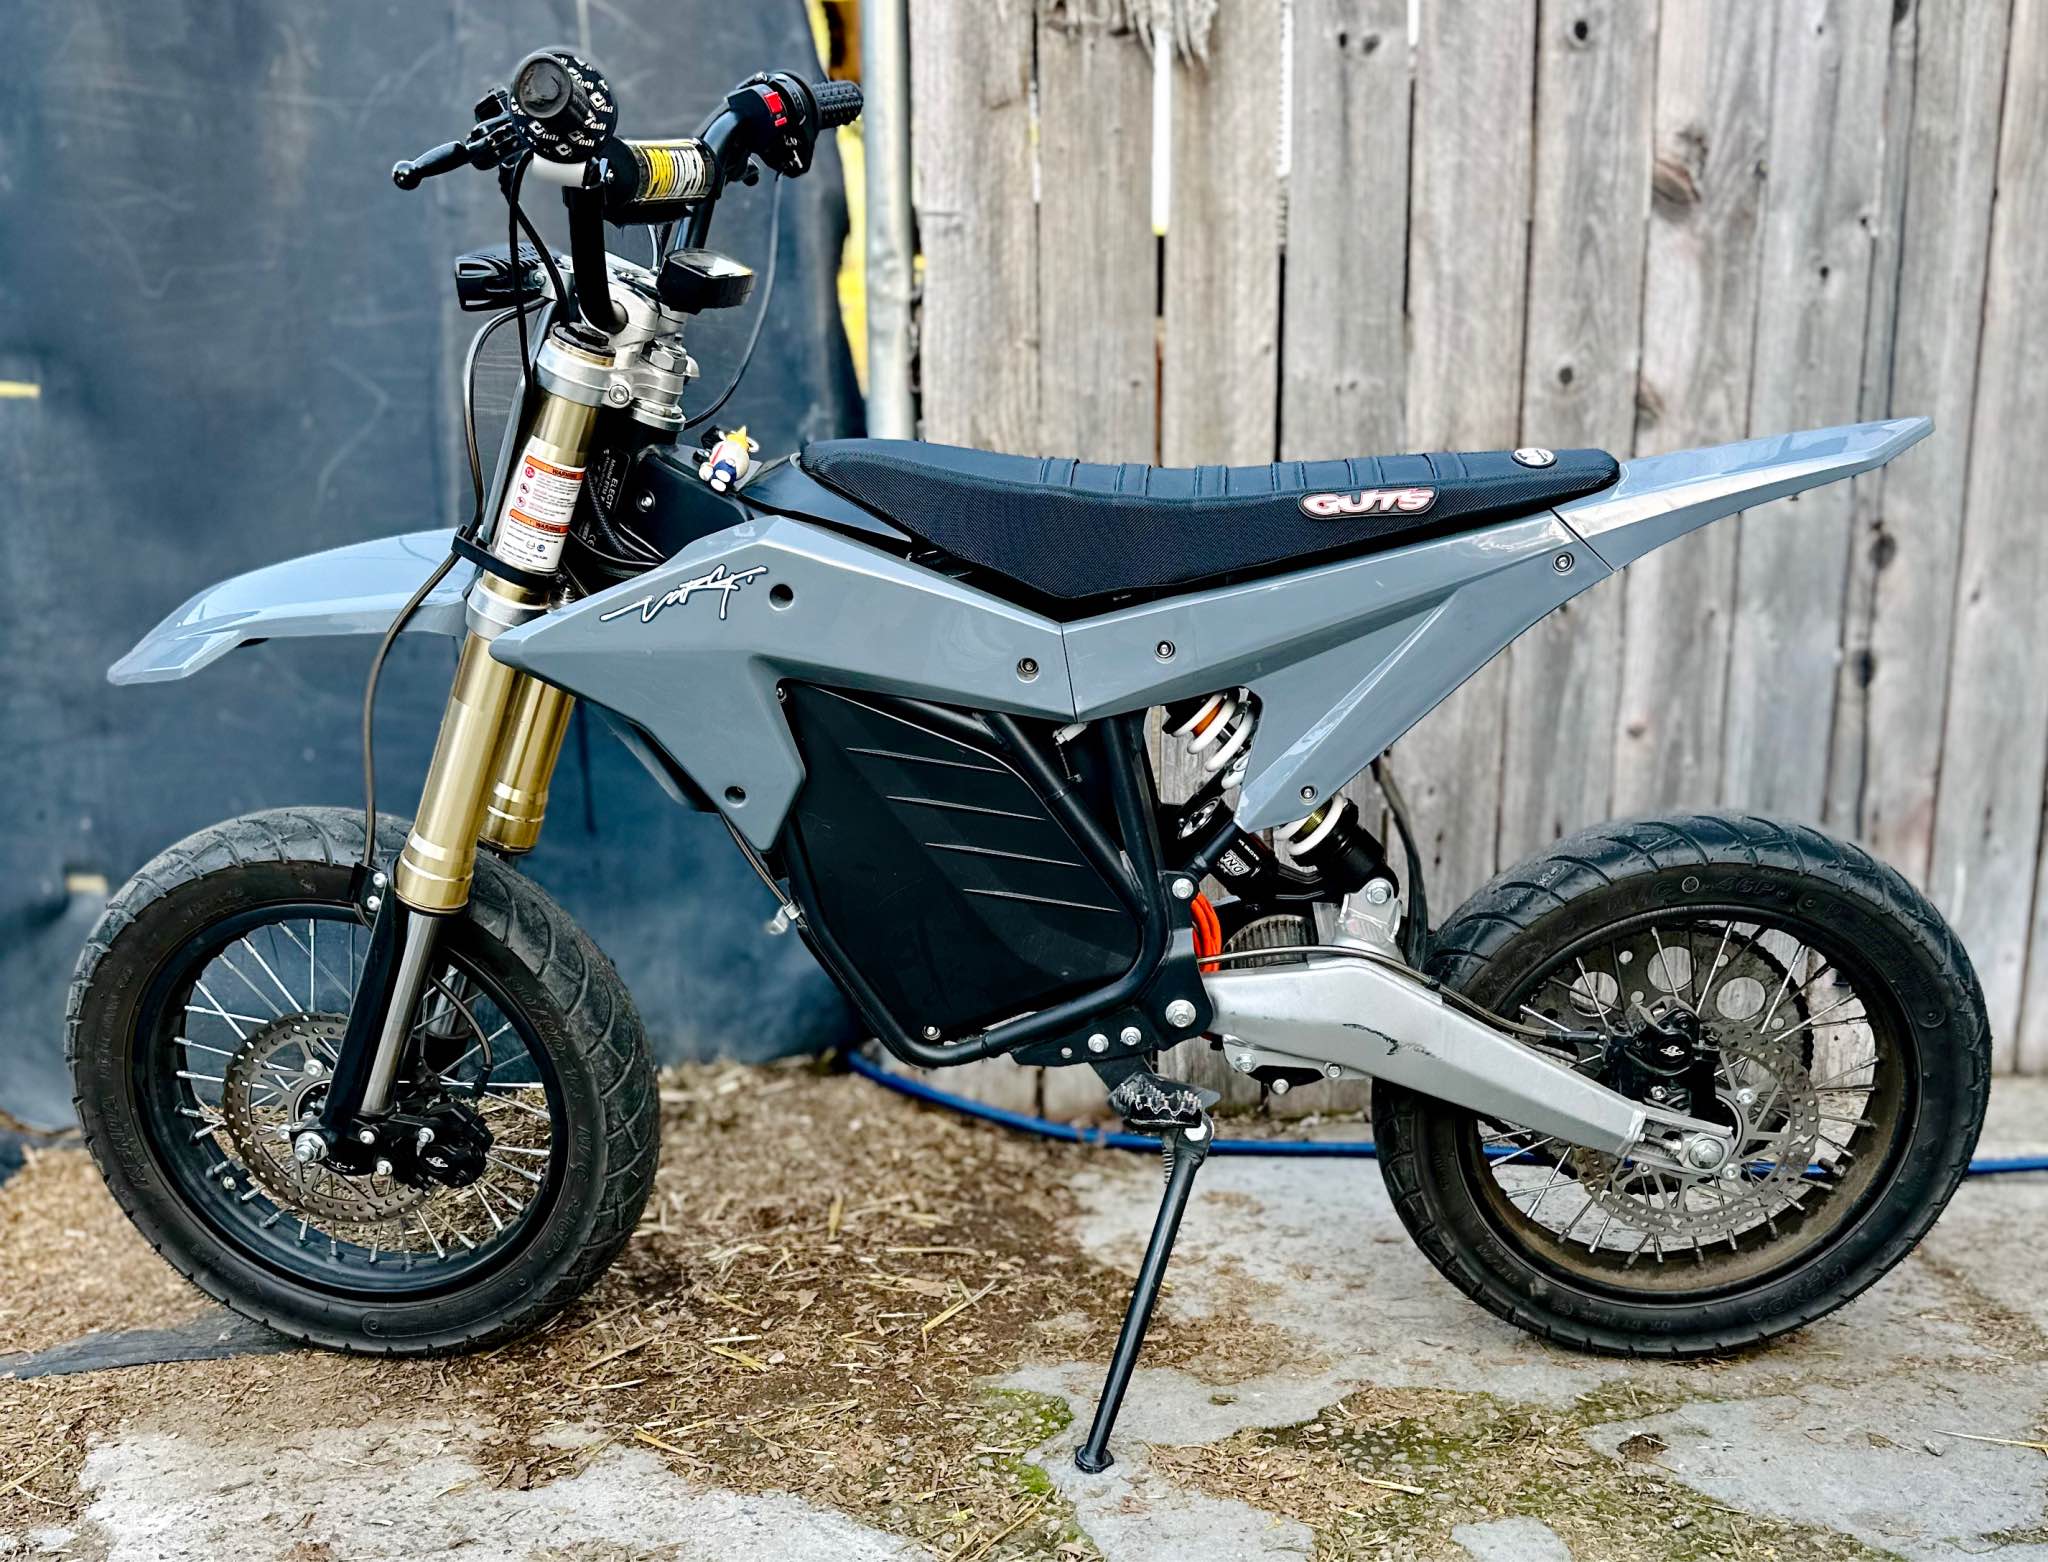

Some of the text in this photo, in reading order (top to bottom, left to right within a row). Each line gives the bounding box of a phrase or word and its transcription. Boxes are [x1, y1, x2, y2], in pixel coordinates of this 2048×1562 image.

[1303, 490, 1434, 516] GUTS
[102, 1095, 150, 1189] KENDA
[1747, 1263, 1847, 1322] KENDA
